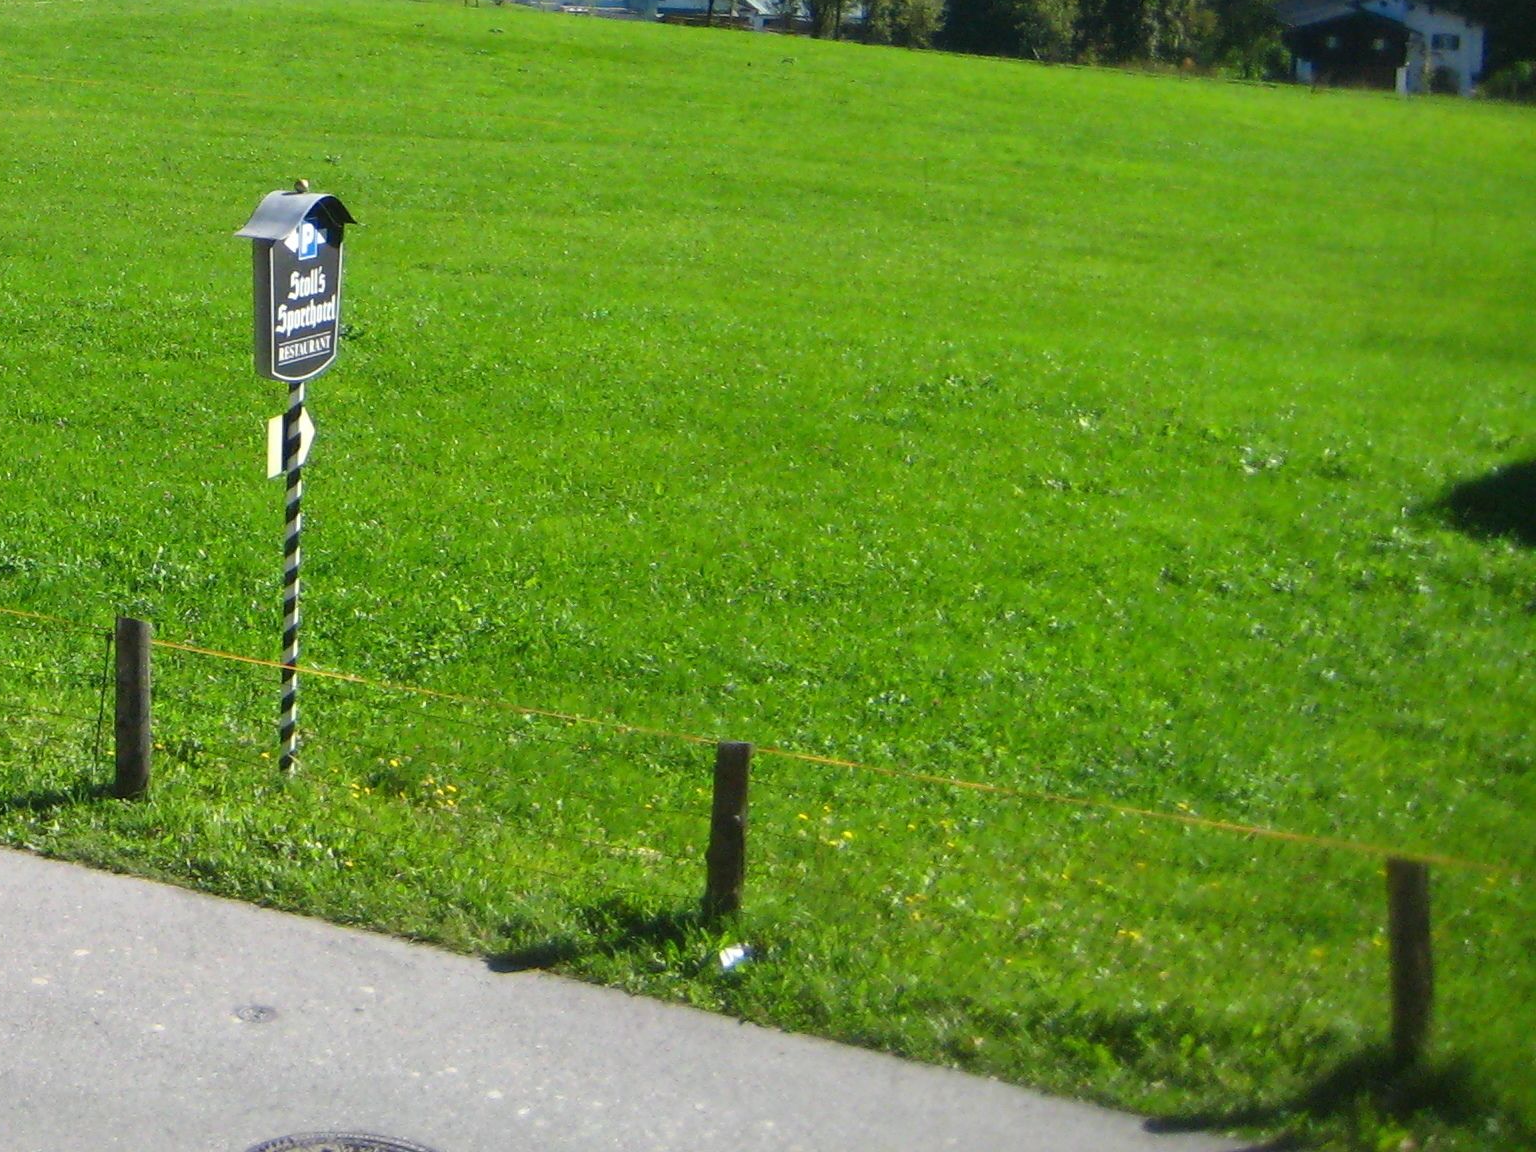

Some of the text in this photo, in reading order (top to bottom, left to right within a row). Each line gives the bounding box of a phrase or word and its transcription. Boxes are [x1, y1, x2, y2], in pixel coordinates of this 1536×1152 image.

[301, 222, 314, 254] P
[288, 266, 326, 300] Stoll's
[276, 294, 336, 337] Sporthotel
[278, 335, 331, 361] RESTAURANT
